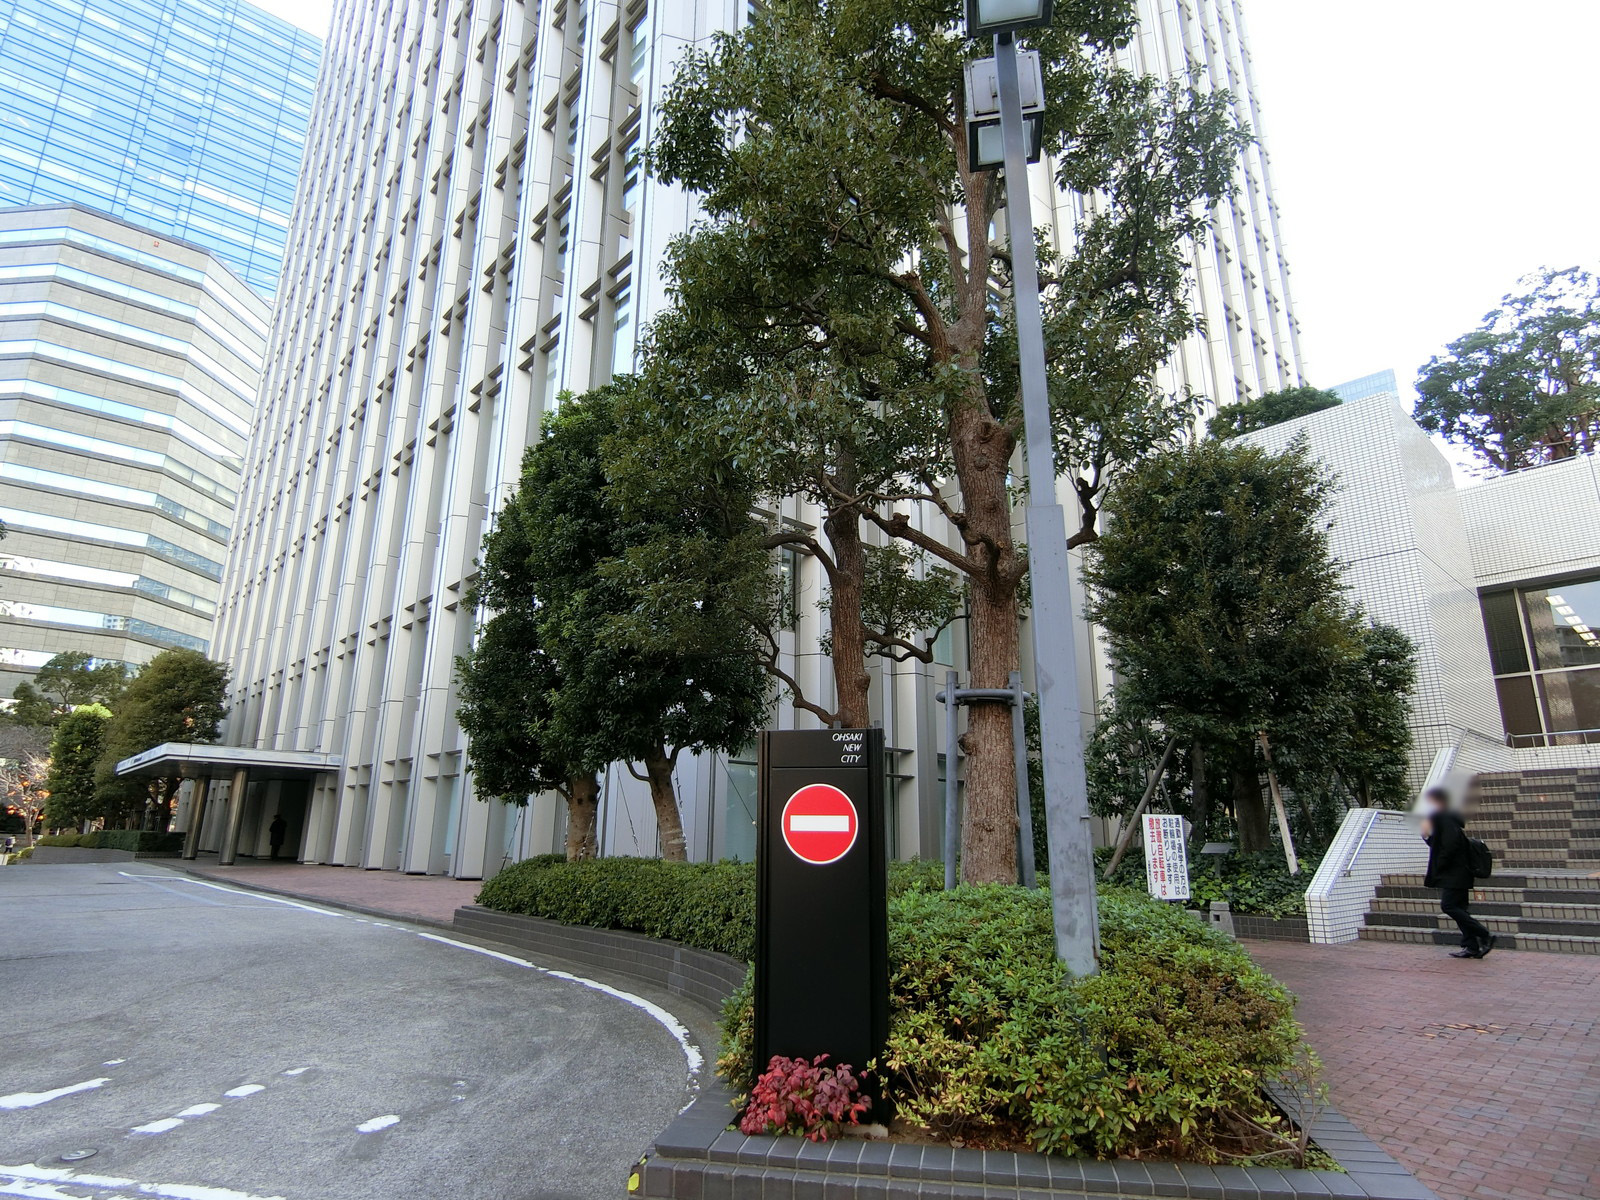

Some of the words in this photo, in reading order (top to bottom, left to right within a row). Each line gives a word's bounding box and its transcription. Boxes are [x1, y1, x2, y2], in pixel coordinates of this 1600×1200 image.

[832, 732, 863, 742] OHSAKI
[842, 743, 862, 752] NEW
[840, 754, 861, 763] CITY
[1155, 817, 1167, 896] 放置自転車は
